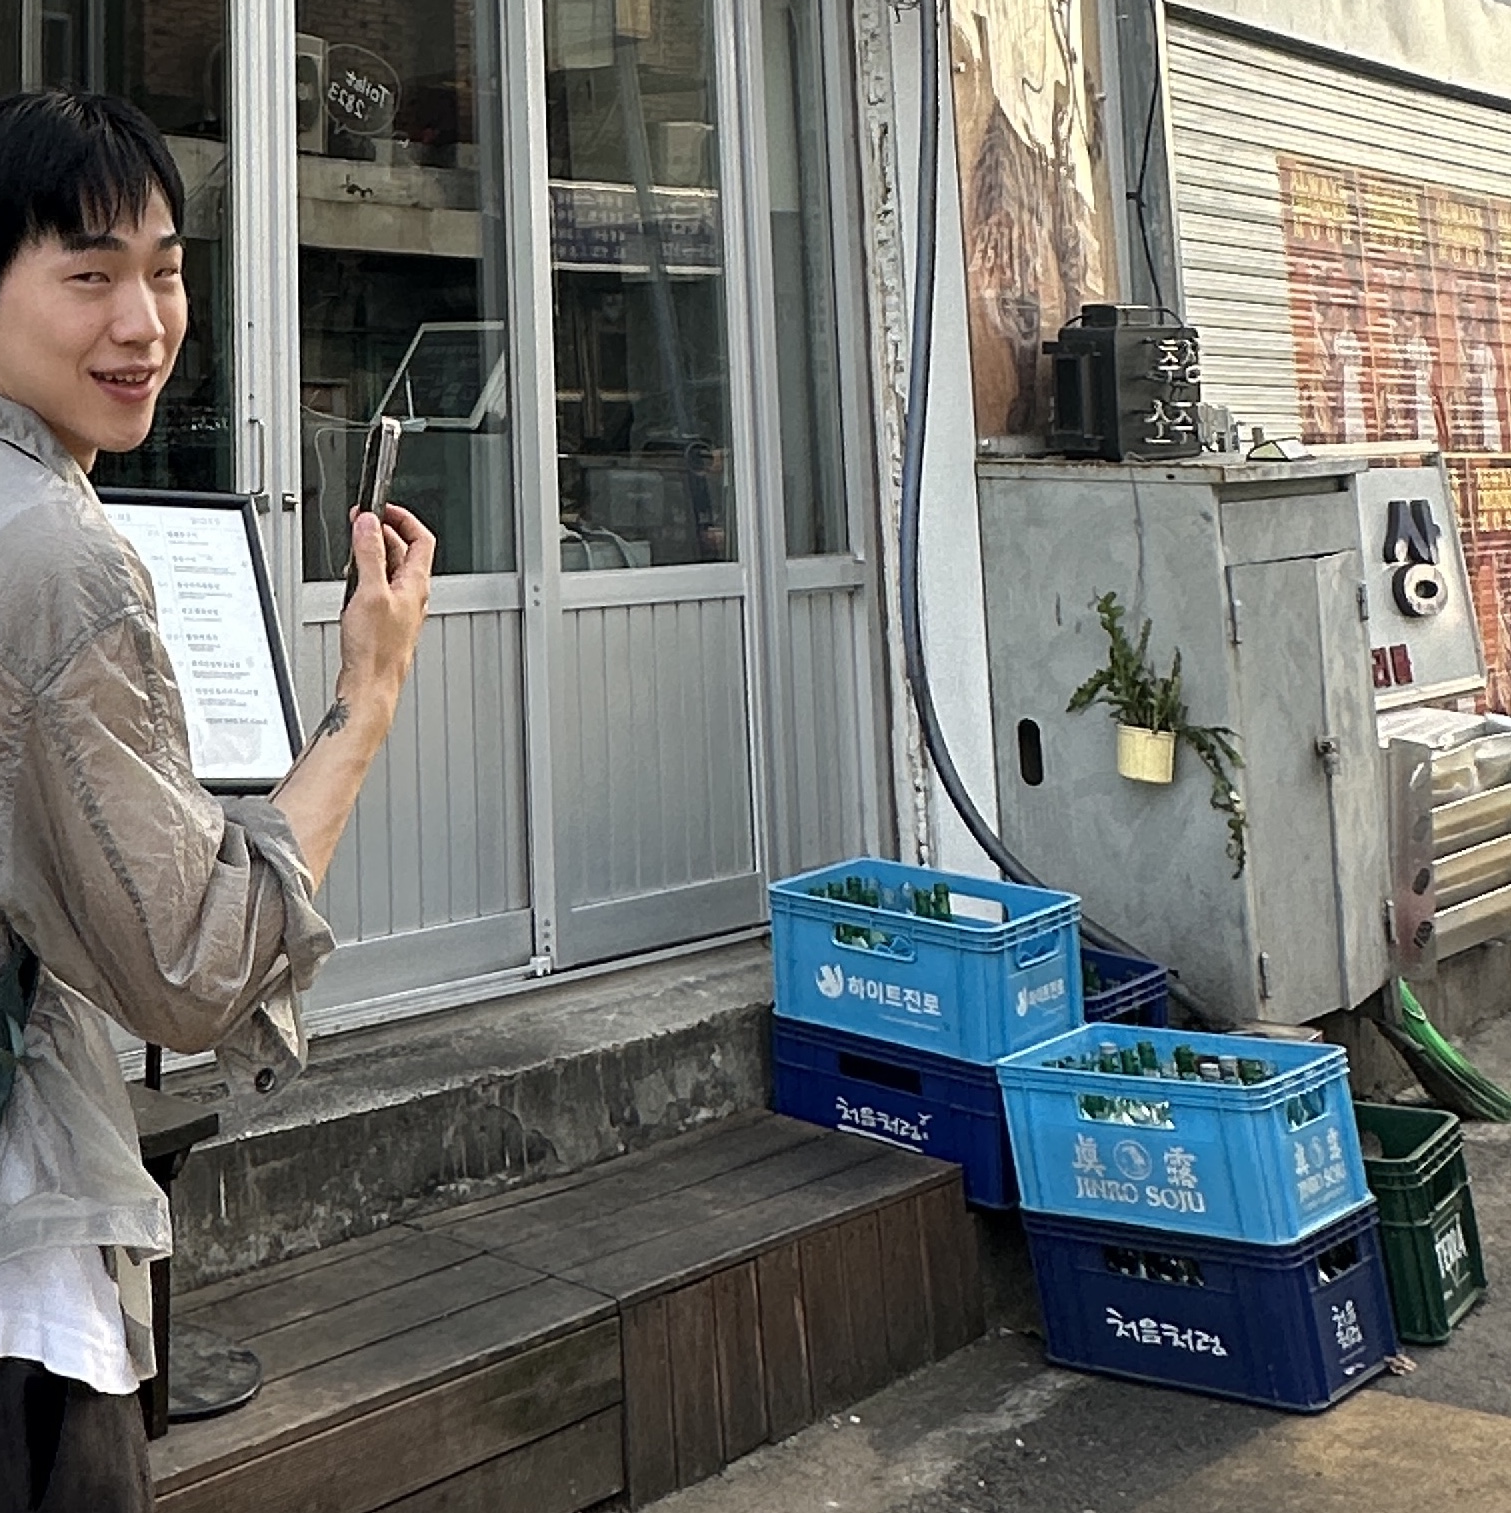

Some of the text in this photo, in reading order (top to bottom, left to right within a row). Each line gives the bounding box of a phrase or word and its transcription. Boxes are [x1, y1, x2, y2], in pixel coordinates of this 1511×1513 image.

[848, 975, 942, 1016] 하이트진로
[1076, 1176, 1206, 1213] JINRO SOJU
[1105, 1307, 1229, 1357] 처음처럼
